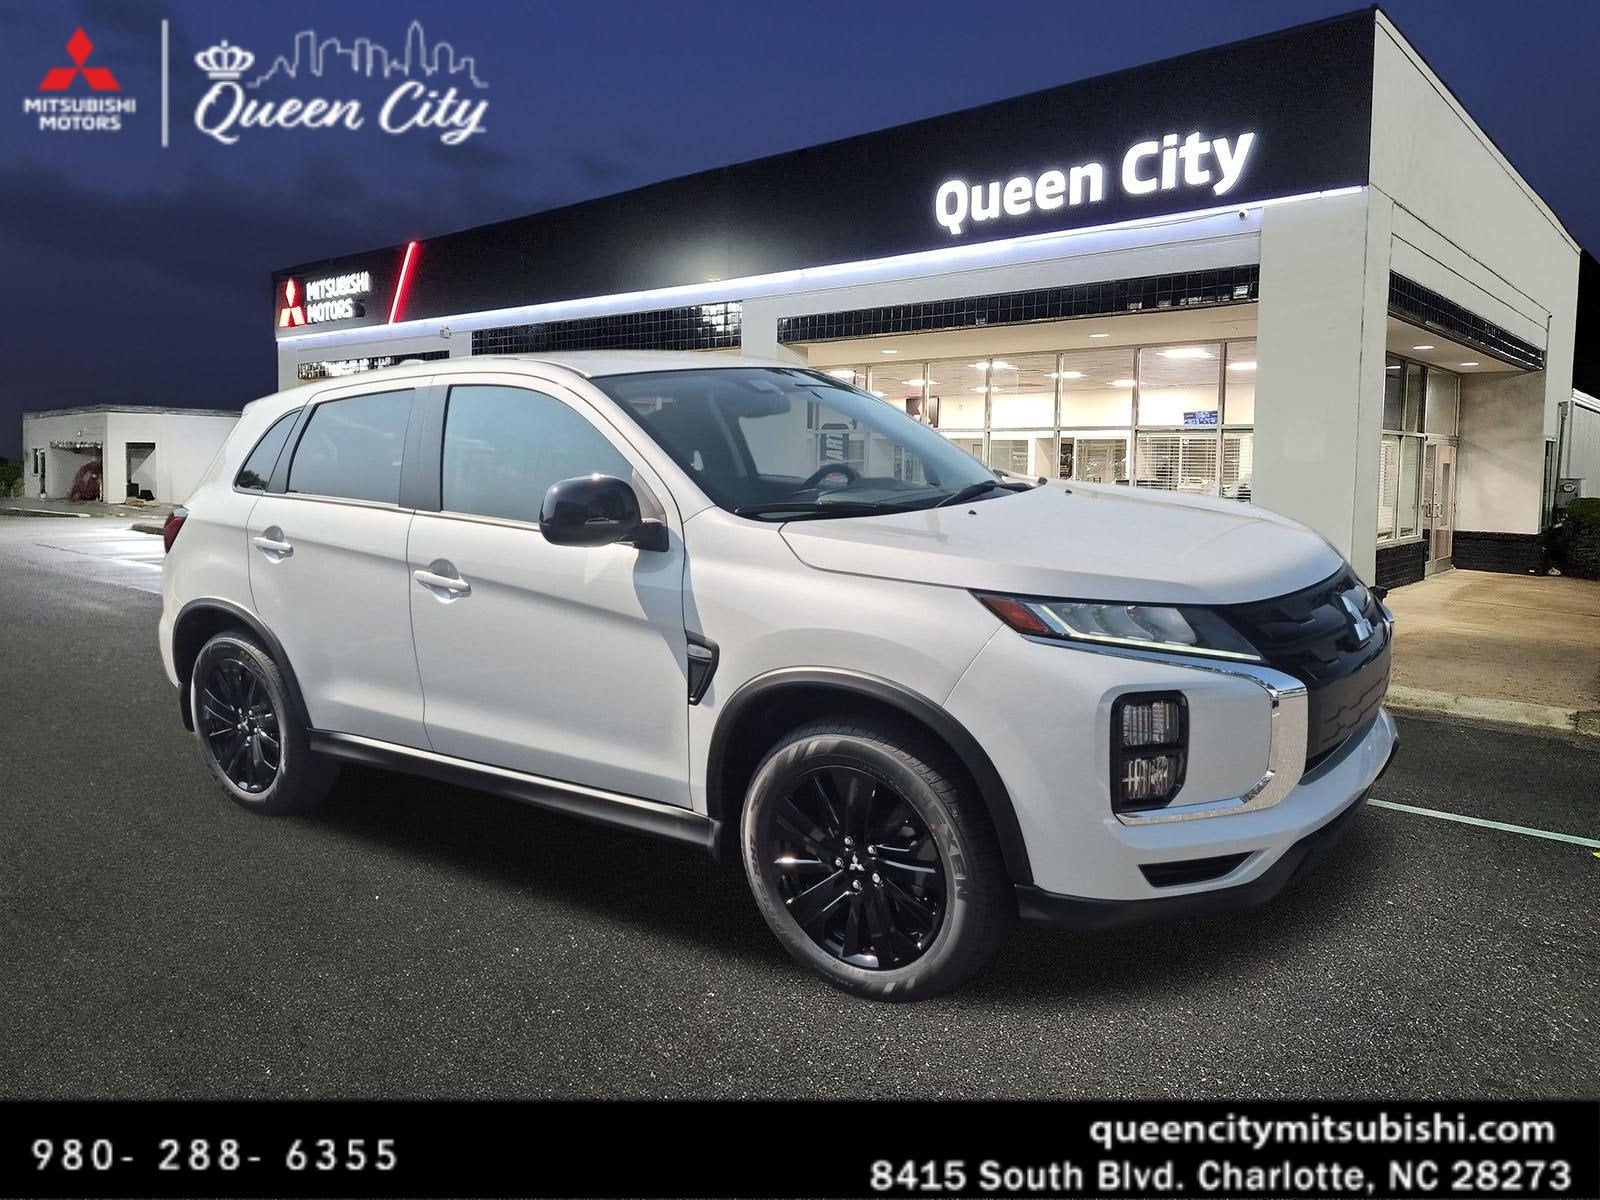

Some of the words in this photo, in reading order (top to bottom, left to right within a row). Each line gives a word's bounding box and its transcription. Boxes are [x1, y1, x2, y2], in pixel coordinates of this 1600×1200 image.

[935, 161, 1104, 235] Queen
[1121, 131, 1255, 196] City
[306, 270, 370, 302] MITSUBISHI
[306, 299, 354, 324] MOTORS
